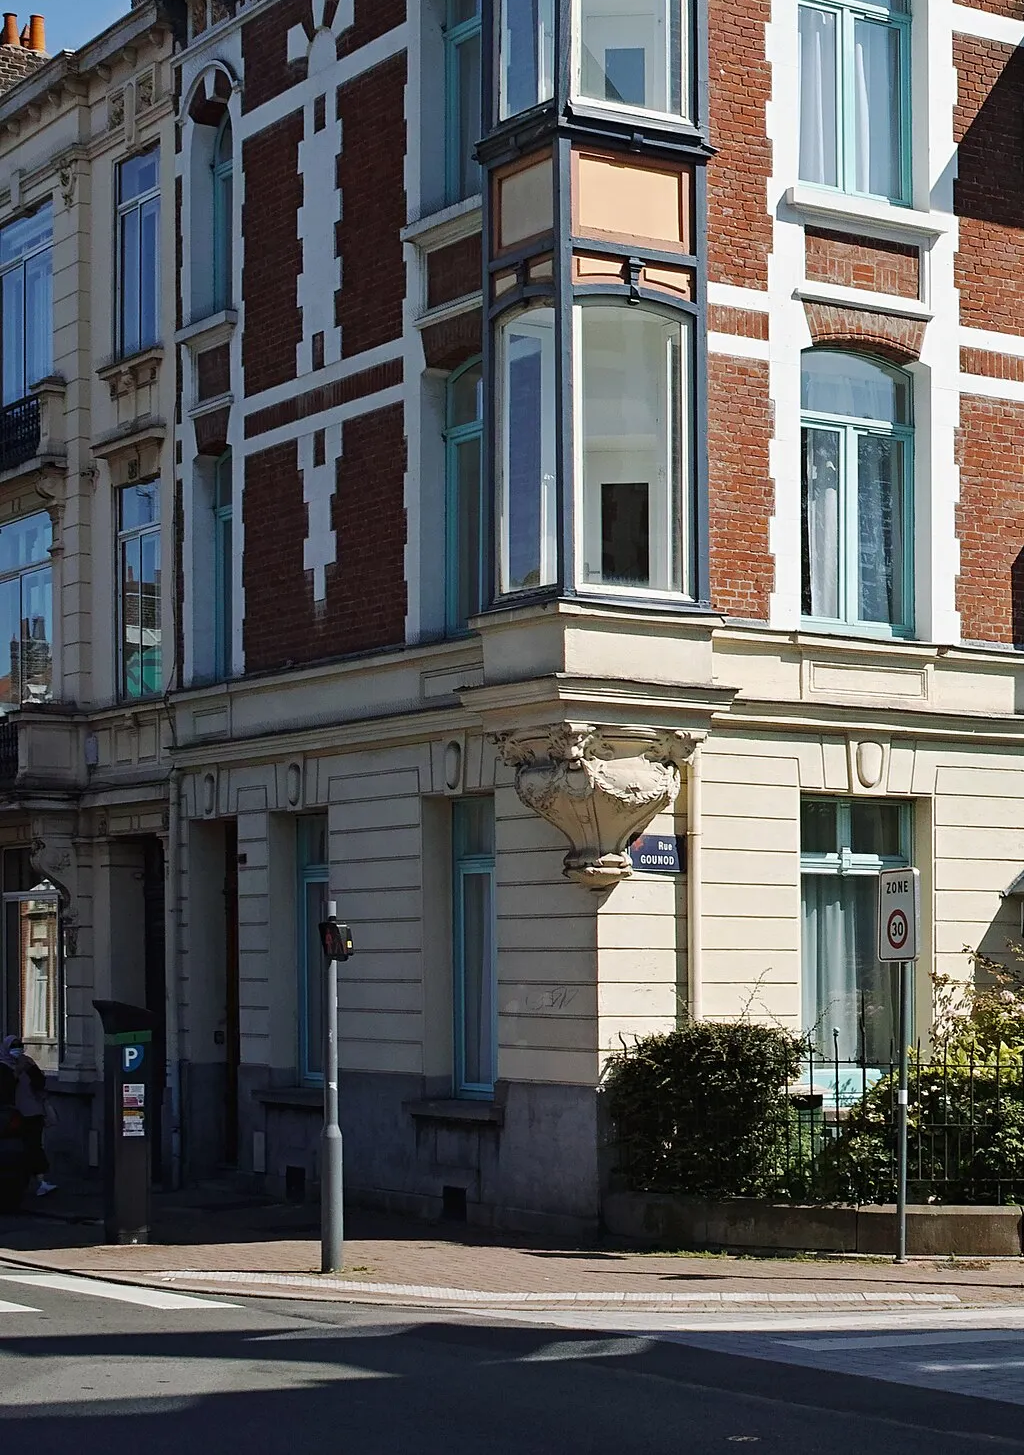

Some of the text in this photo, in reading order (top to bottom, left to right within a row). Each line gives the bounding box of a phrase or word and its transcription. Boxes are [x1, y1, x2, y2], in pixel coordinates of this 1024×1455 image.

[658, 840, 673, 851] Rue
[640, 854, 675, 865] GOUNOD
[886, 880, 909, 894] ZONE
[891, 921, 904, 937] 30
[125, 1047, 139, 1067] P
